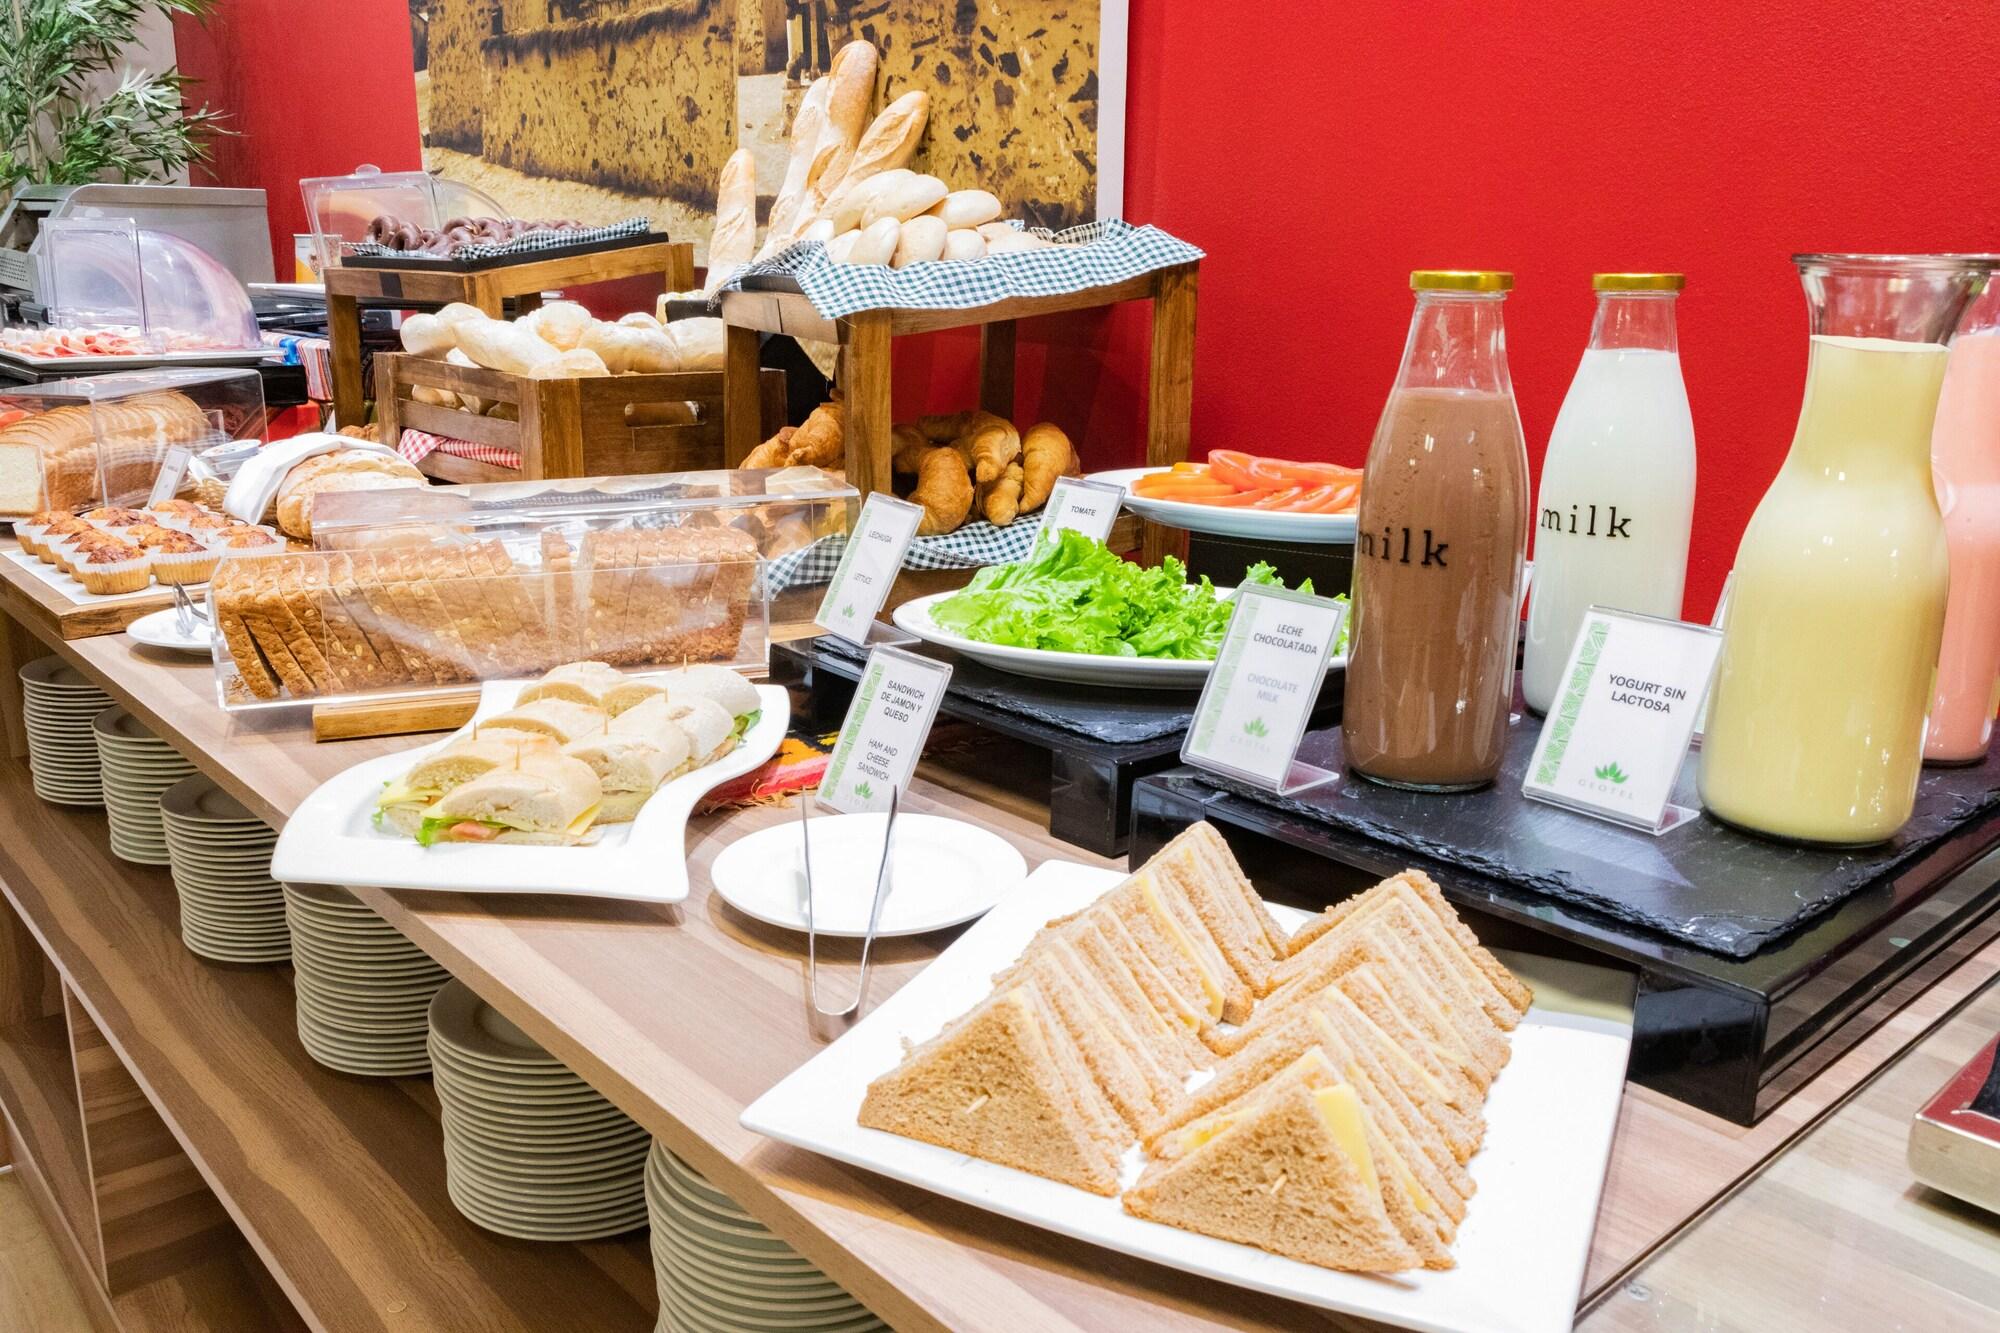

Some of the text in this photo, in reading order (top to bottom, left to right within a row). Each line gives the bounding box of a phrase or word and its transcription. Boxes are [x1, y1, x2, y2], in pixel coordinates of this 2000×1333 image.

[1071, 505, 1096, 516] TOMATE
[1541, 504, 1632, 538] milk
[868, 530, 893, 542] LECHUGA
[1359, 526, 1449, 567] milk
[1276, 623, 1304, 636] LECHE
[1253, 632, 1318, 654] CHOCOLATADA
[887, 679, 926, 699] SANDWICH
[1247, 672, 1299, 693] CHOCOLATE
[1608, 674, 1687, 700] YOGURT SIN
[880, 691, 923, 713] DE JAMON Y
[1256, 689, 1279, 703] MILK
[1611, 691, 1671, 713] LACTOSA
[883, 706, 909, 722] QUESO
[868, 738, 898, 757] HAM AND
[866, 751, 891, 768] CHEESE
[857, 761, 890, 781] SANDWICH
